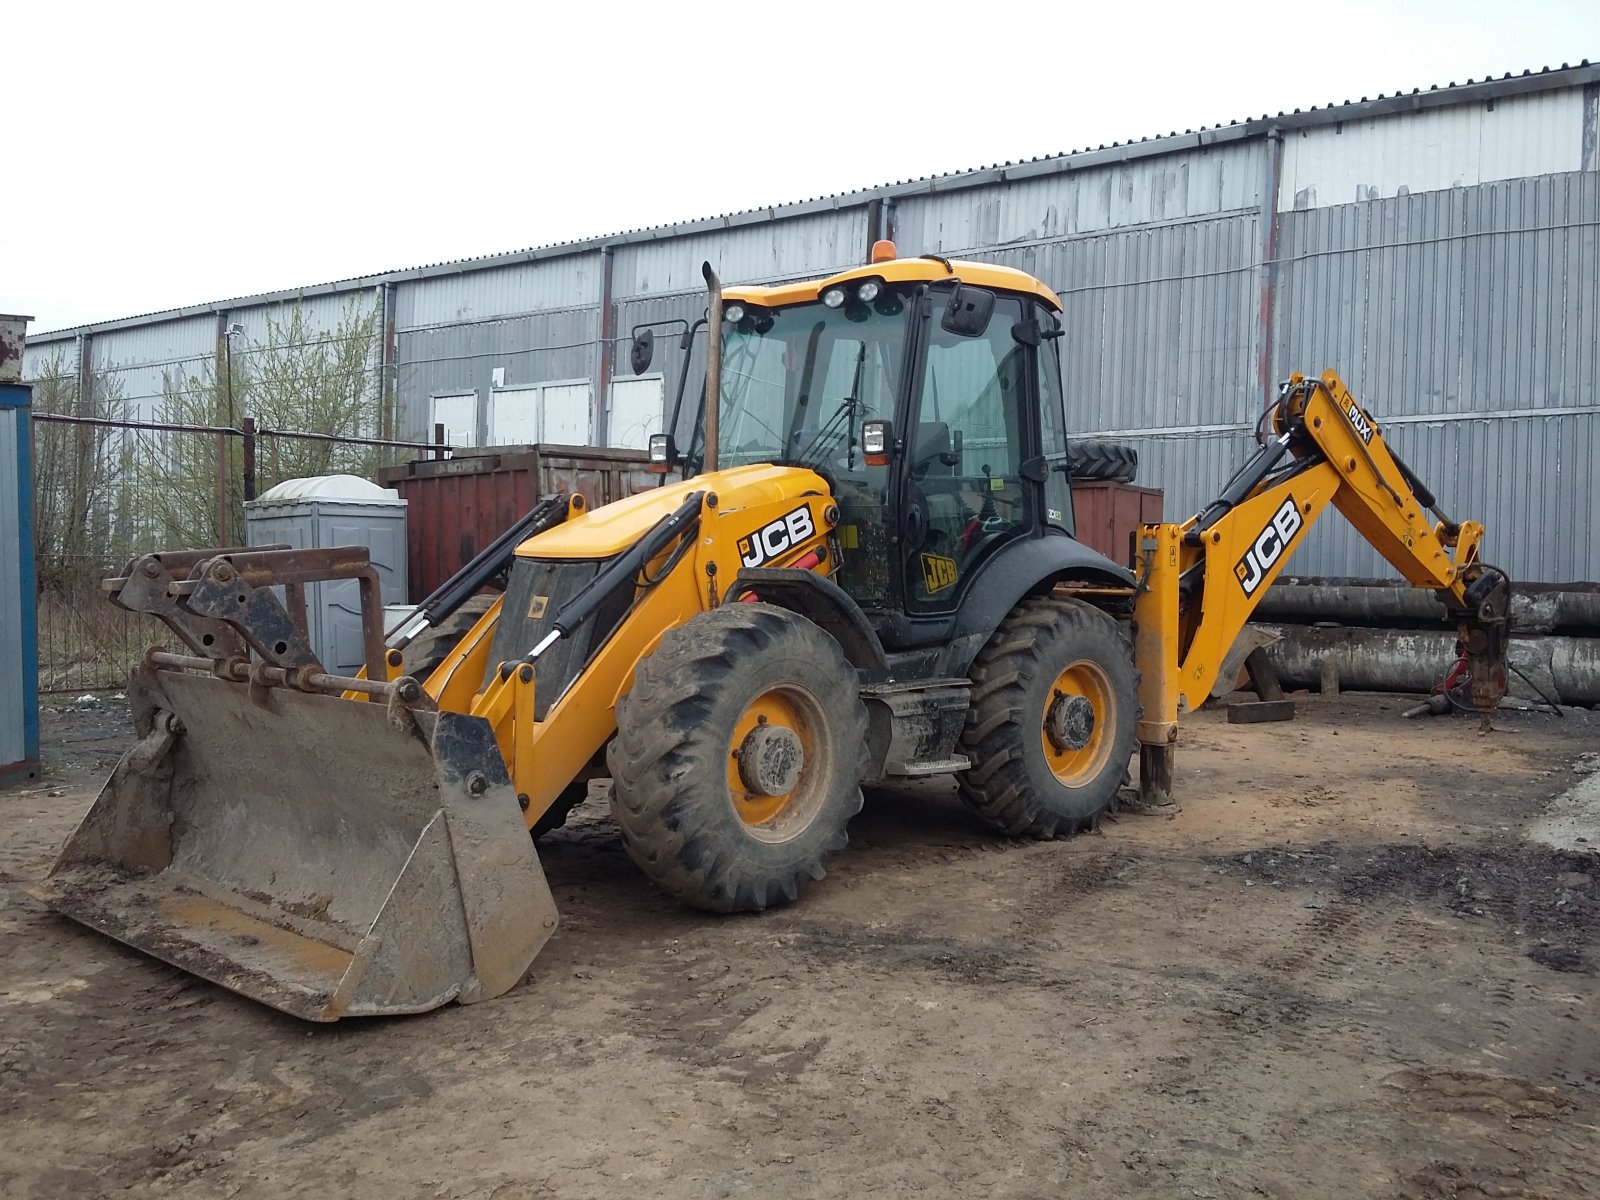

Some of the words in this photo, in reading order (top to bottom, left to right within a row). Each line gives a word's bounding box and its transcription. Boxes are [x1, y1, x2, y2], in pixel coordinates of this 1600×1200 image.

[743, 507, 813, 568] JCB
[1243, 500, 1301, 592] JCB
[927, 557, 956, 590] JCB
